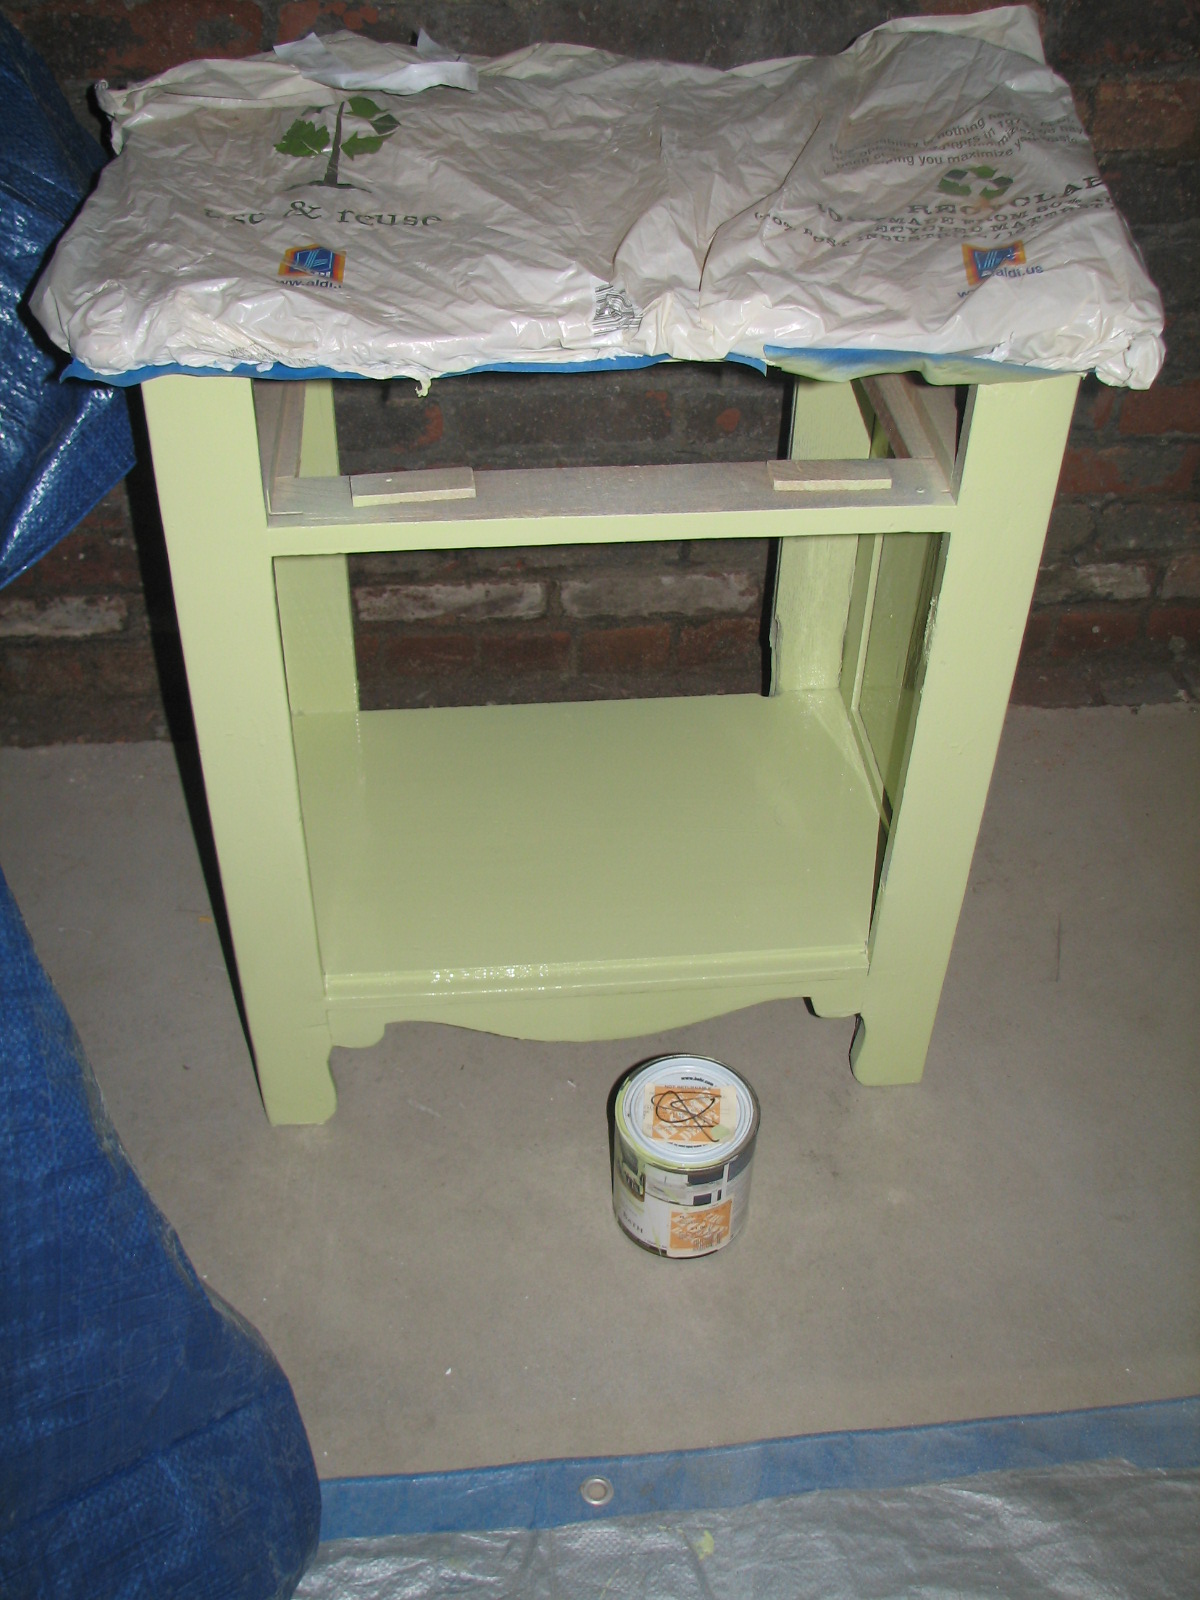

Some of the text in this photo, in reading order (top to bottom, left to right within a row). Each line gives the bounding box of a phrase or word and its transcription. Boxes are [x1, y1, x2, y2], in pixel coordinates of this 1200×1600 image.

[937, 117, 986, 139] nothing
[918, 155, 943, 167] you
[947, 148, 1013, 164] maximize
[282, 200, 322, 220] &
[336, 207, 443, 227] reuse
